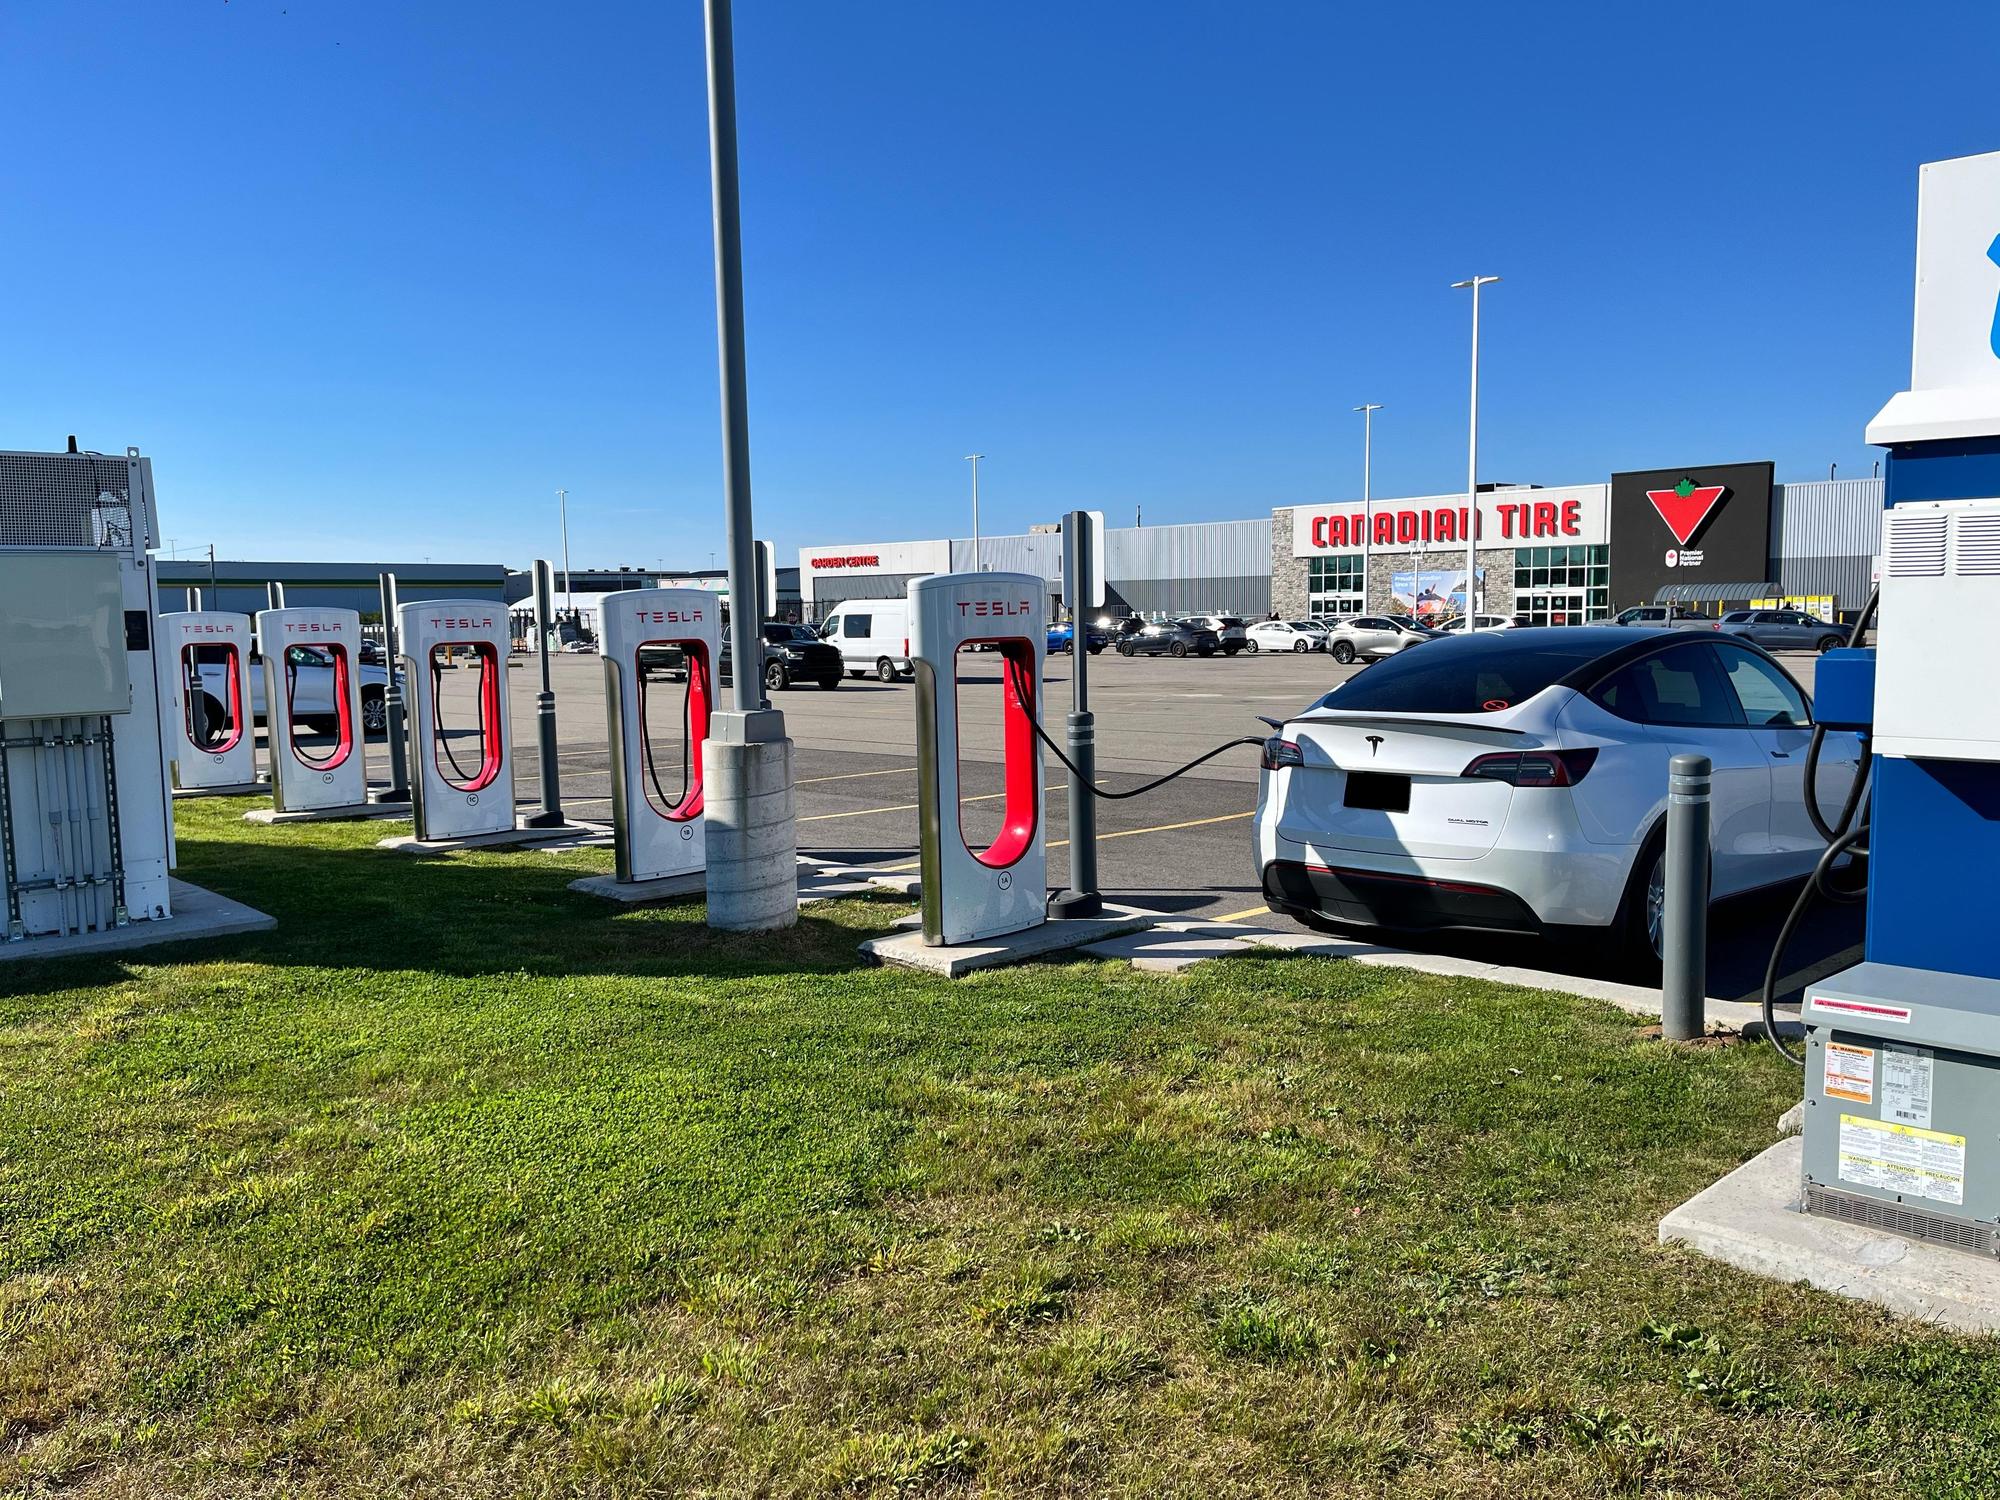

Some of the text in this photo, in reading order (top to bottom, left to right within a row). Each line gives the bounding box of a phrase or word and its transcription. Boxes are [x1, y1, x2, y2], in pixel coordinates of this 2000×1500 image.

[1311, 500, 1581, 548] CANADIAN TIRE
[811, 555, 880, 569] GARDEN CENTRE
[956, 601, 1030, 616] TESLA
[636, 611, 703, 623] TESLA
[182, 625, 234, 633] TESLA
[284, 623, 342, 632] TESLA
[430, 618, 492, 629] TESLA
[1840, 1047, 1864, 1055] WARNING
[1848, 1155, 1872, 1165] WARNING
[1886, 1163, 1916, 1173] ATTENTION
